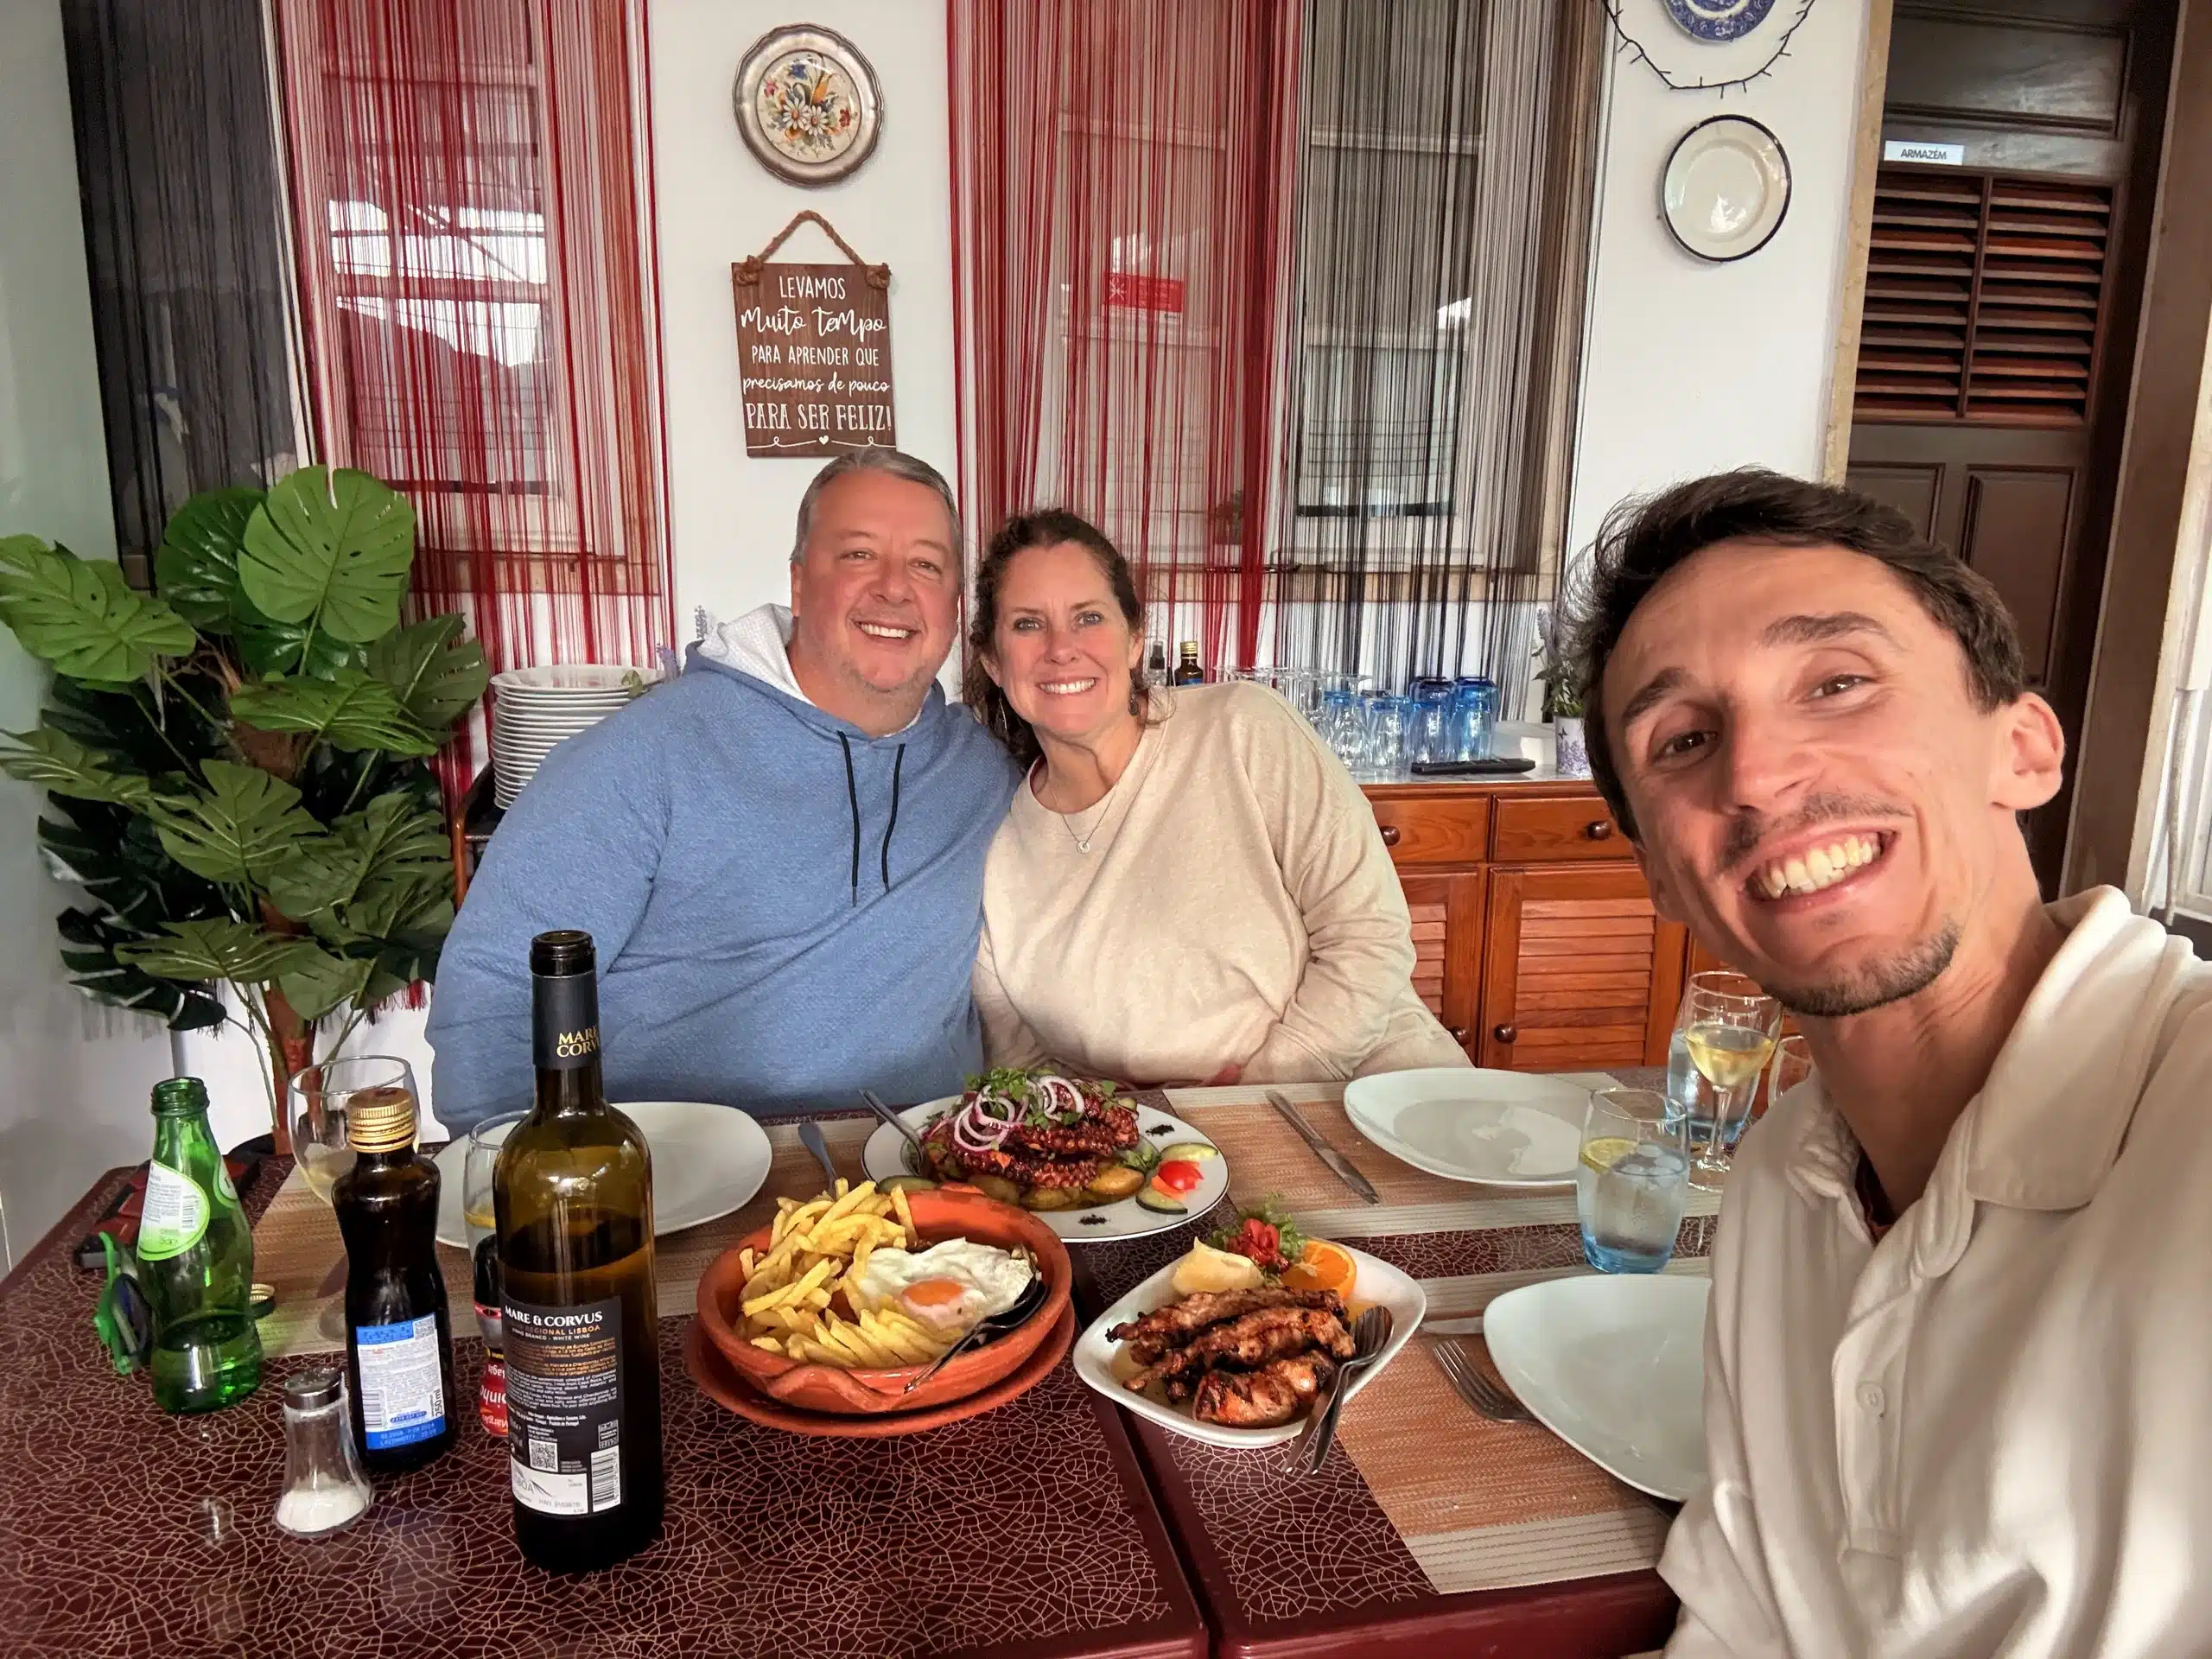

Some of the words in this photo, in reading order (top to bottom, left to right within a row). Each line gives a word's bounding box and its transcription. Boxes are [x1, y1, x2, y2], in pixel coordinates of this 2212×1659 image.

[1901, 147, 1948, 161] ARMAZÉM
[779, 276, 846, 300] LEVAMOS
[752, 345, 781, 365] PARA
[788, 346, 849, 365] APRENDER
[855, 347, 880, 366] QUE
[743, 377, 824, 396] precisamos
[828, 372, 845, 394] de
[849, 379, 890, 397] pouco
[745, 403, 791, 429] PARA
[798, 404, 830, 430] SER
[836, 404, 892, 431] FELIZ!
[505, 1305, 531, 1324] MARE
[532, 1315, 542, 1325] &
[544, 1312, 603, 1327] CORVUS
[569, 1325, 601, 1335] LISBOA
